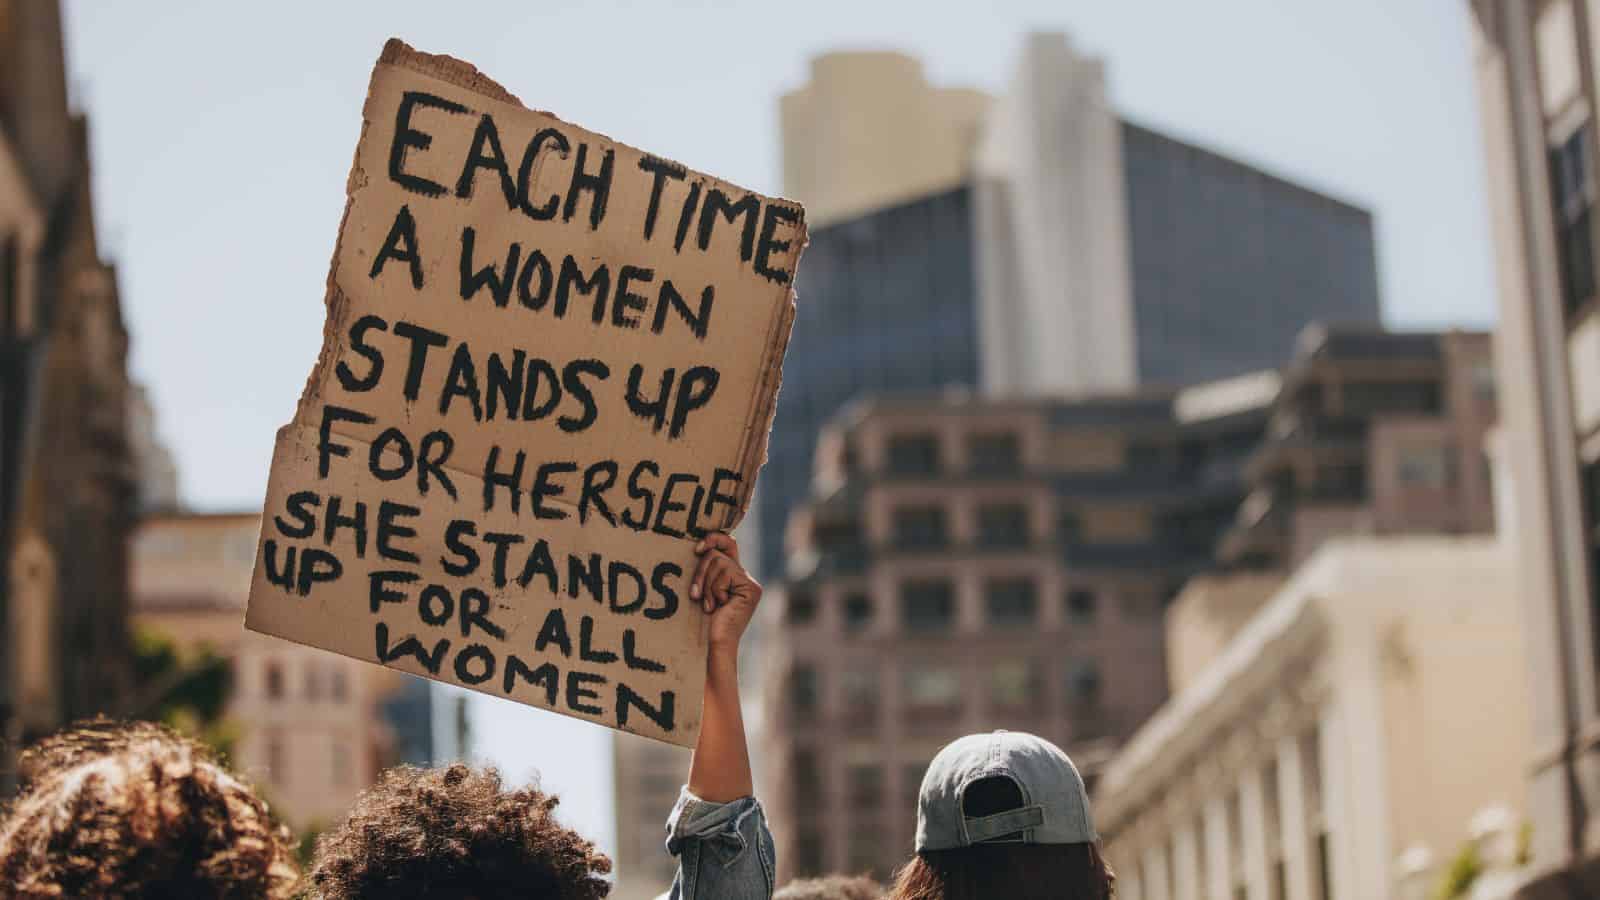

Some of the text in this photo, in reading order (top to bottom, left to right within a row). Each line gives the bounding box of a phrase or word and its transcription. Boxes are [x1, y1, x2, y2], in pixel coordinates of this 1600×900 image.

[388, 91, 801, 284] EACH TIME
[368, 204, 715, 340] A WOMEN
[334, 314, 721, 440] STANDS UP
[316, 404, 743, 540] FOR HERSELF
[264, 538, 667, 673] UP FOR ALL
[274, 490, 683, 621] SHE STANDS
[375, 621, 676, 733] WOMEN
